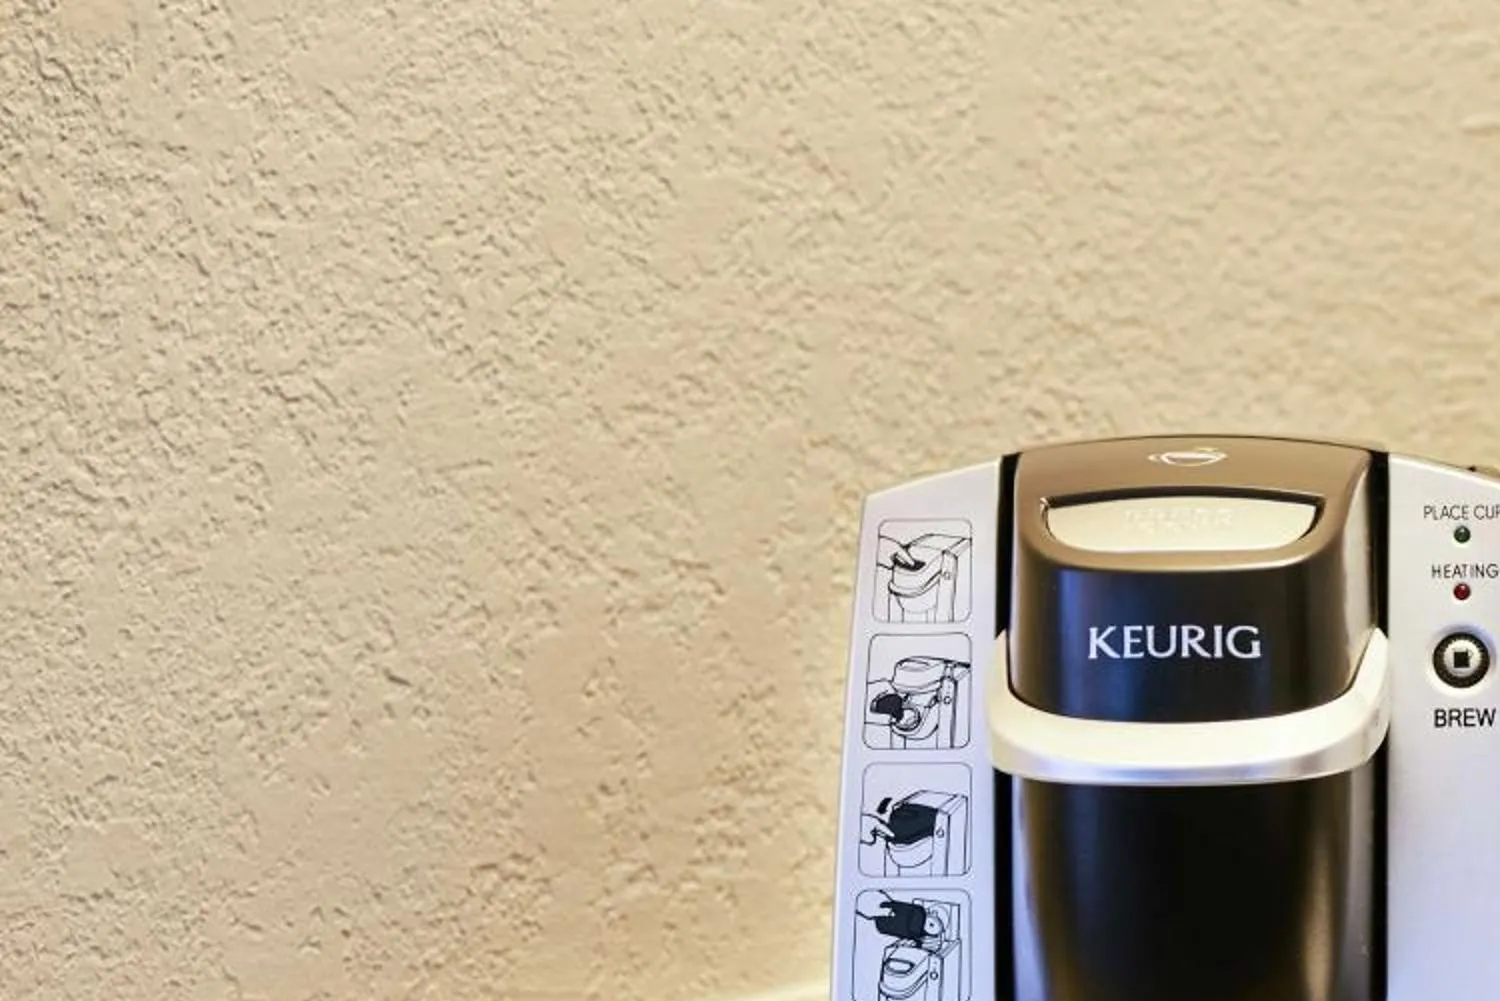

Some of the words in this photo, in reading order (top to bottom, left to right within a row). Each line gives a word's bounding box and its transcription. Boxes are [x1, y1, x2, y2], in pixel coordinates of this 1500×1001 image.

[1423, 505, 1469, 520] PLACE
[1431, 564, 1500, 578] HEATING
[1087, 624, 1262, 660] KEURIG
[1434, 708, 1497, 728] BREW
